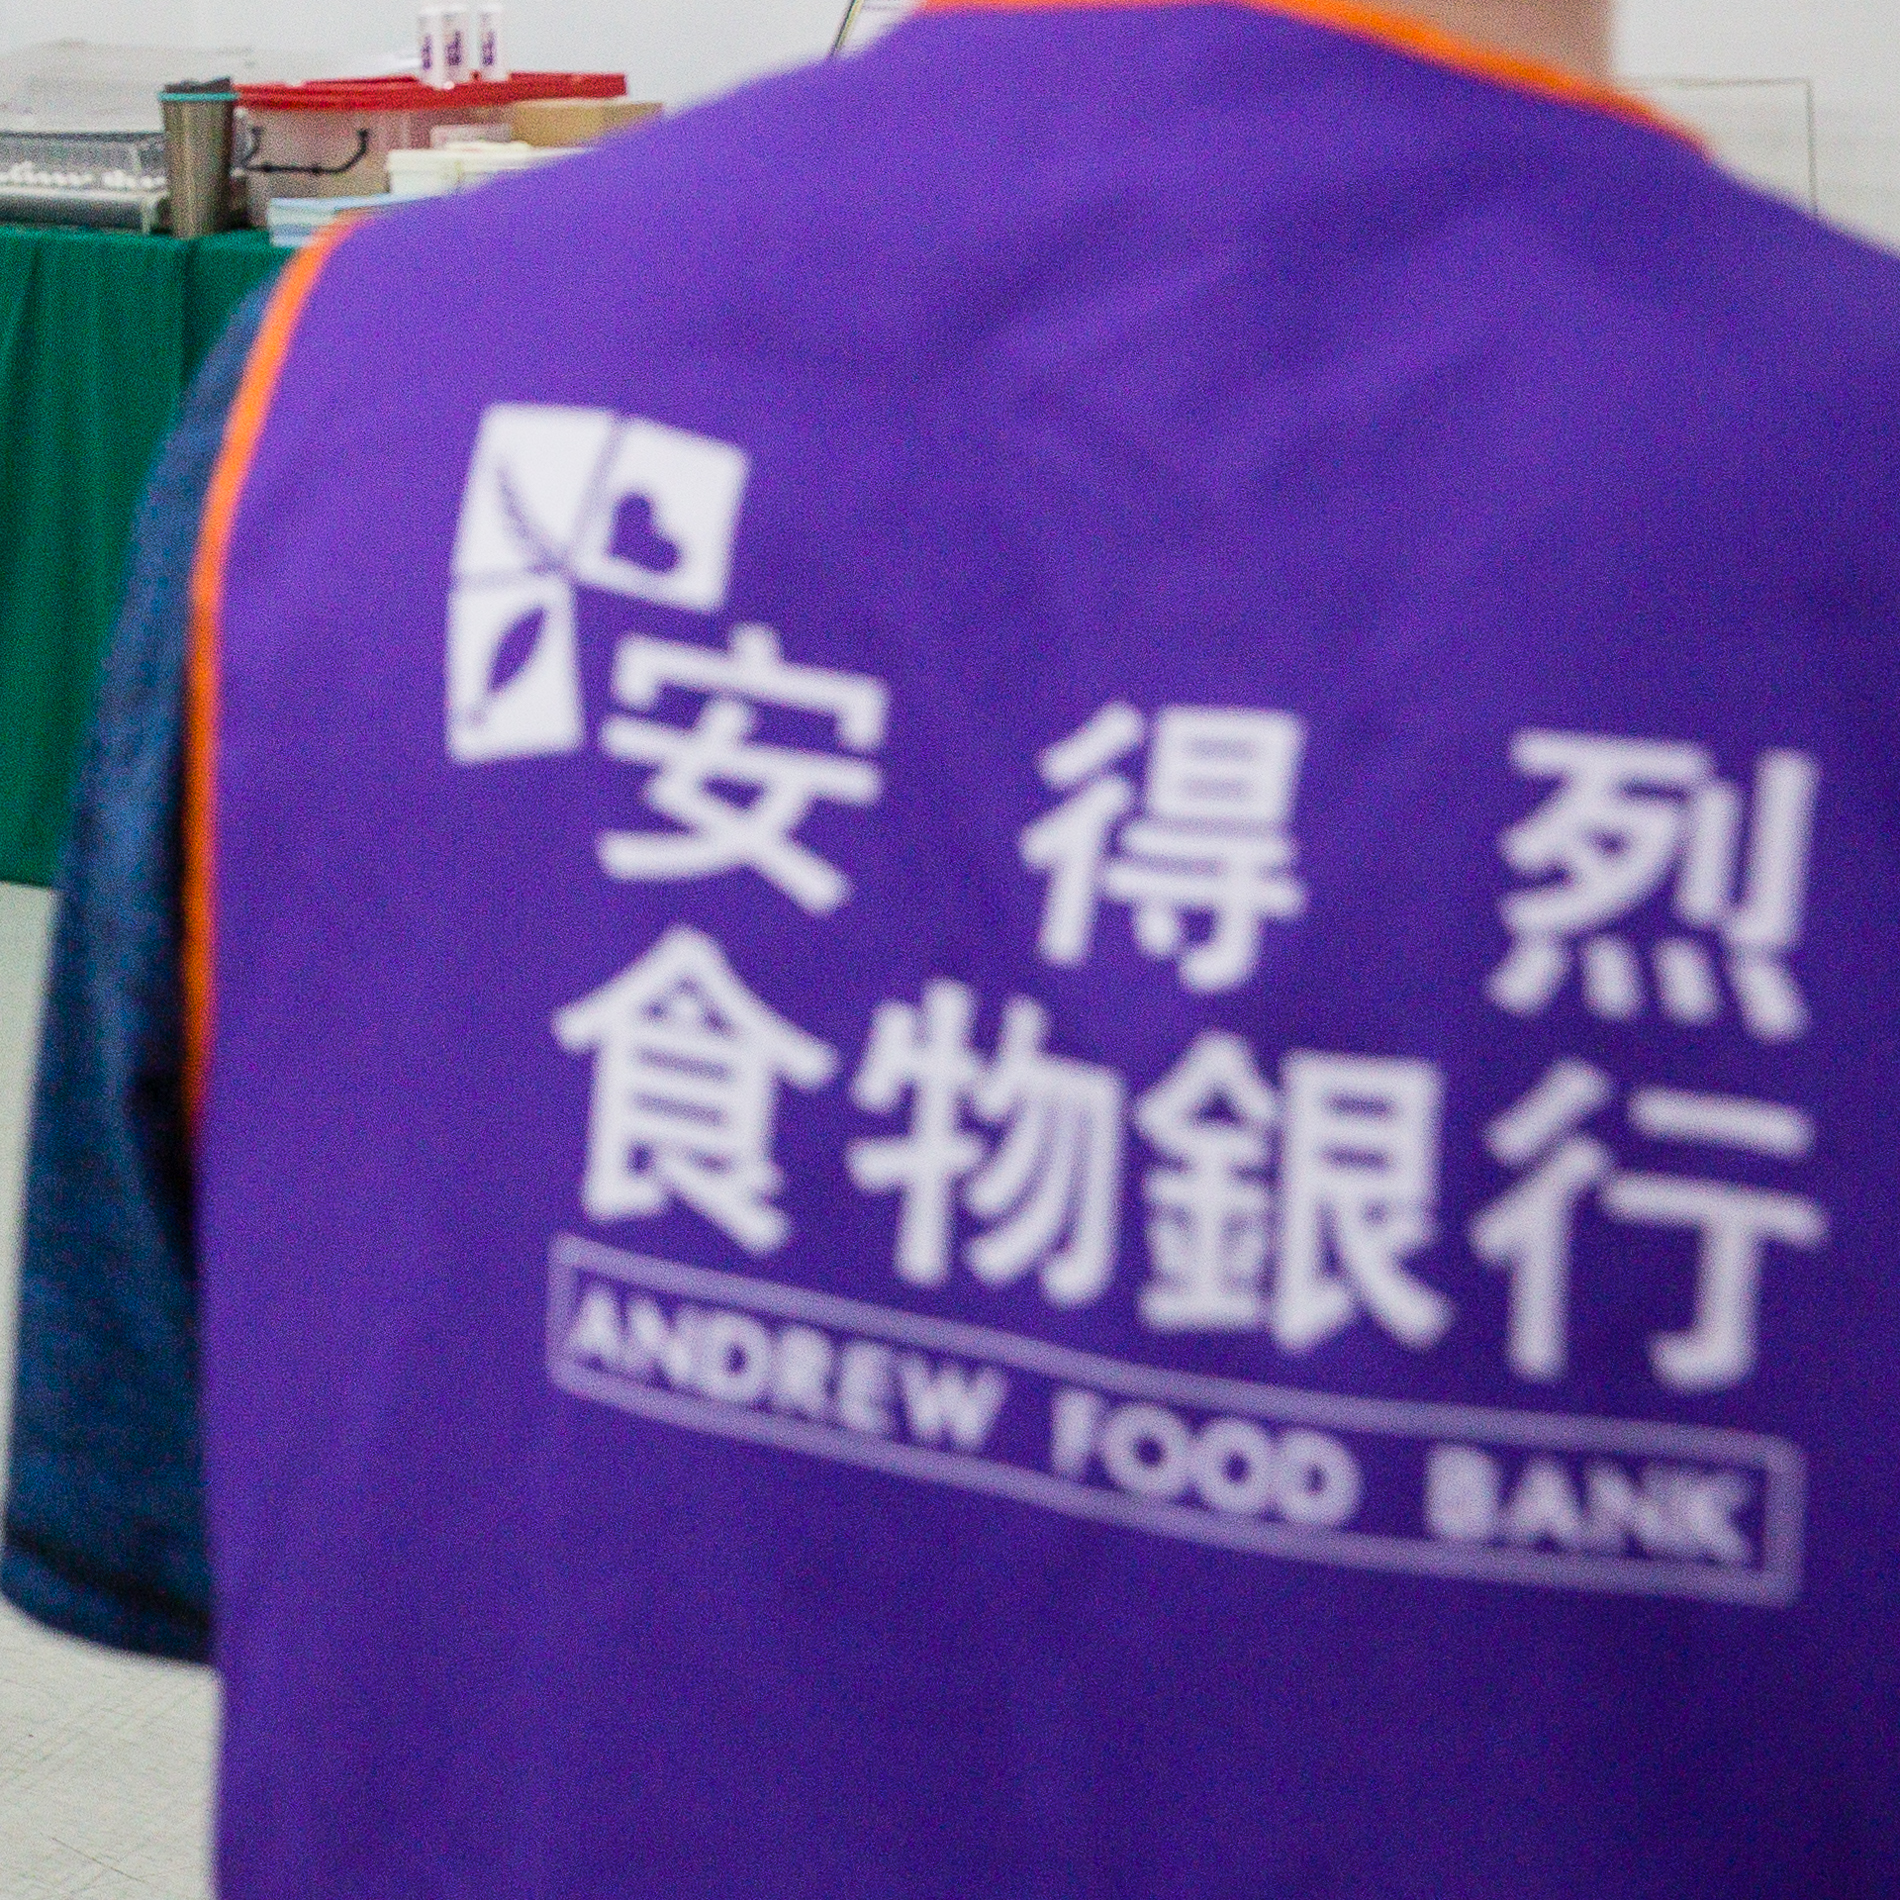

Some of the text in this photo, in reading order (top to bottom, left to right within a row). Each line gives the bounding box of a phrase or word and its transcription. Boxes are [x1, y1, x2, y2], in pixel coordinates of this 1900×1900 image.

[595, 622, 1824, 1041] 安得烈
[552, 924, 1830, 1391] 食物銀行
[569, 1286, 1754, 1563] ANDREW FOOD BANK
